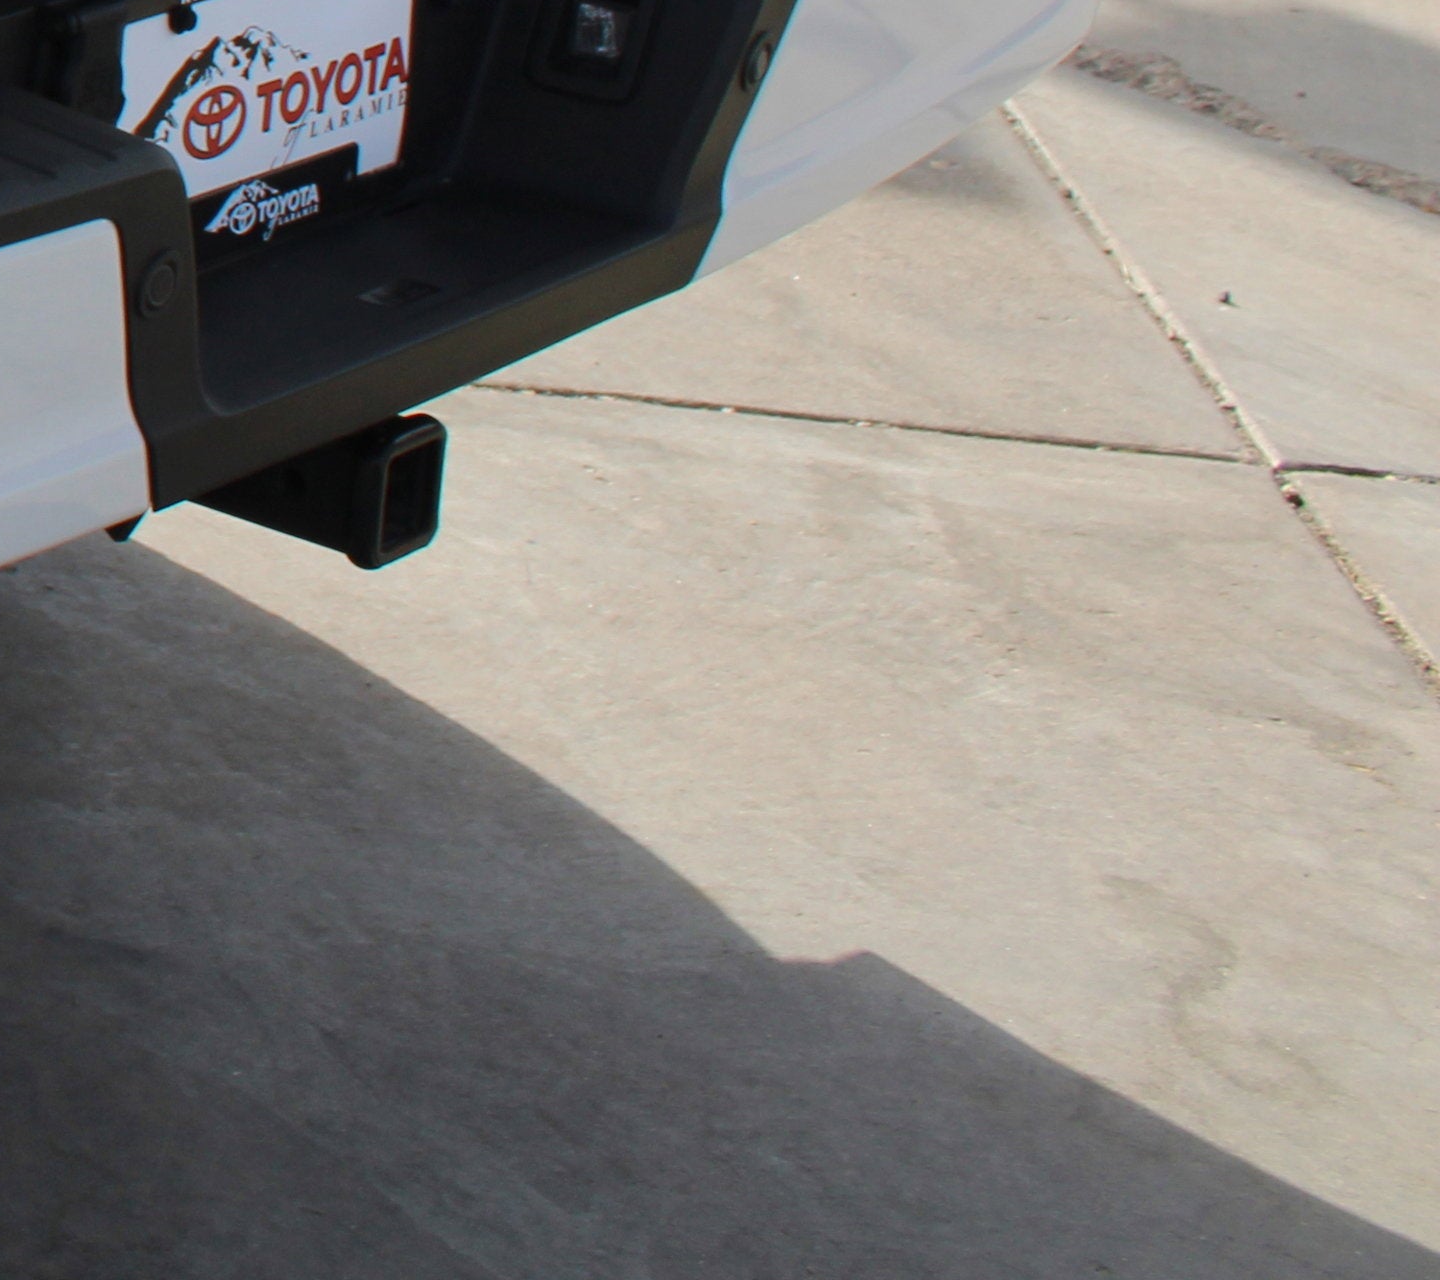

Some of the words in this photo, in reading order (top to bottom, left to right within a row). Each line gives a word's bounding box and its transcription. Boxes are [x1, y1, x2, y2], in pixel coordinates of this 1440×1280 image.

[257, 36, 408, 133] TOYOTA
[309, 89, 408, 139] LARAMIE
[257, 183, 319, 222] TOYOTA
